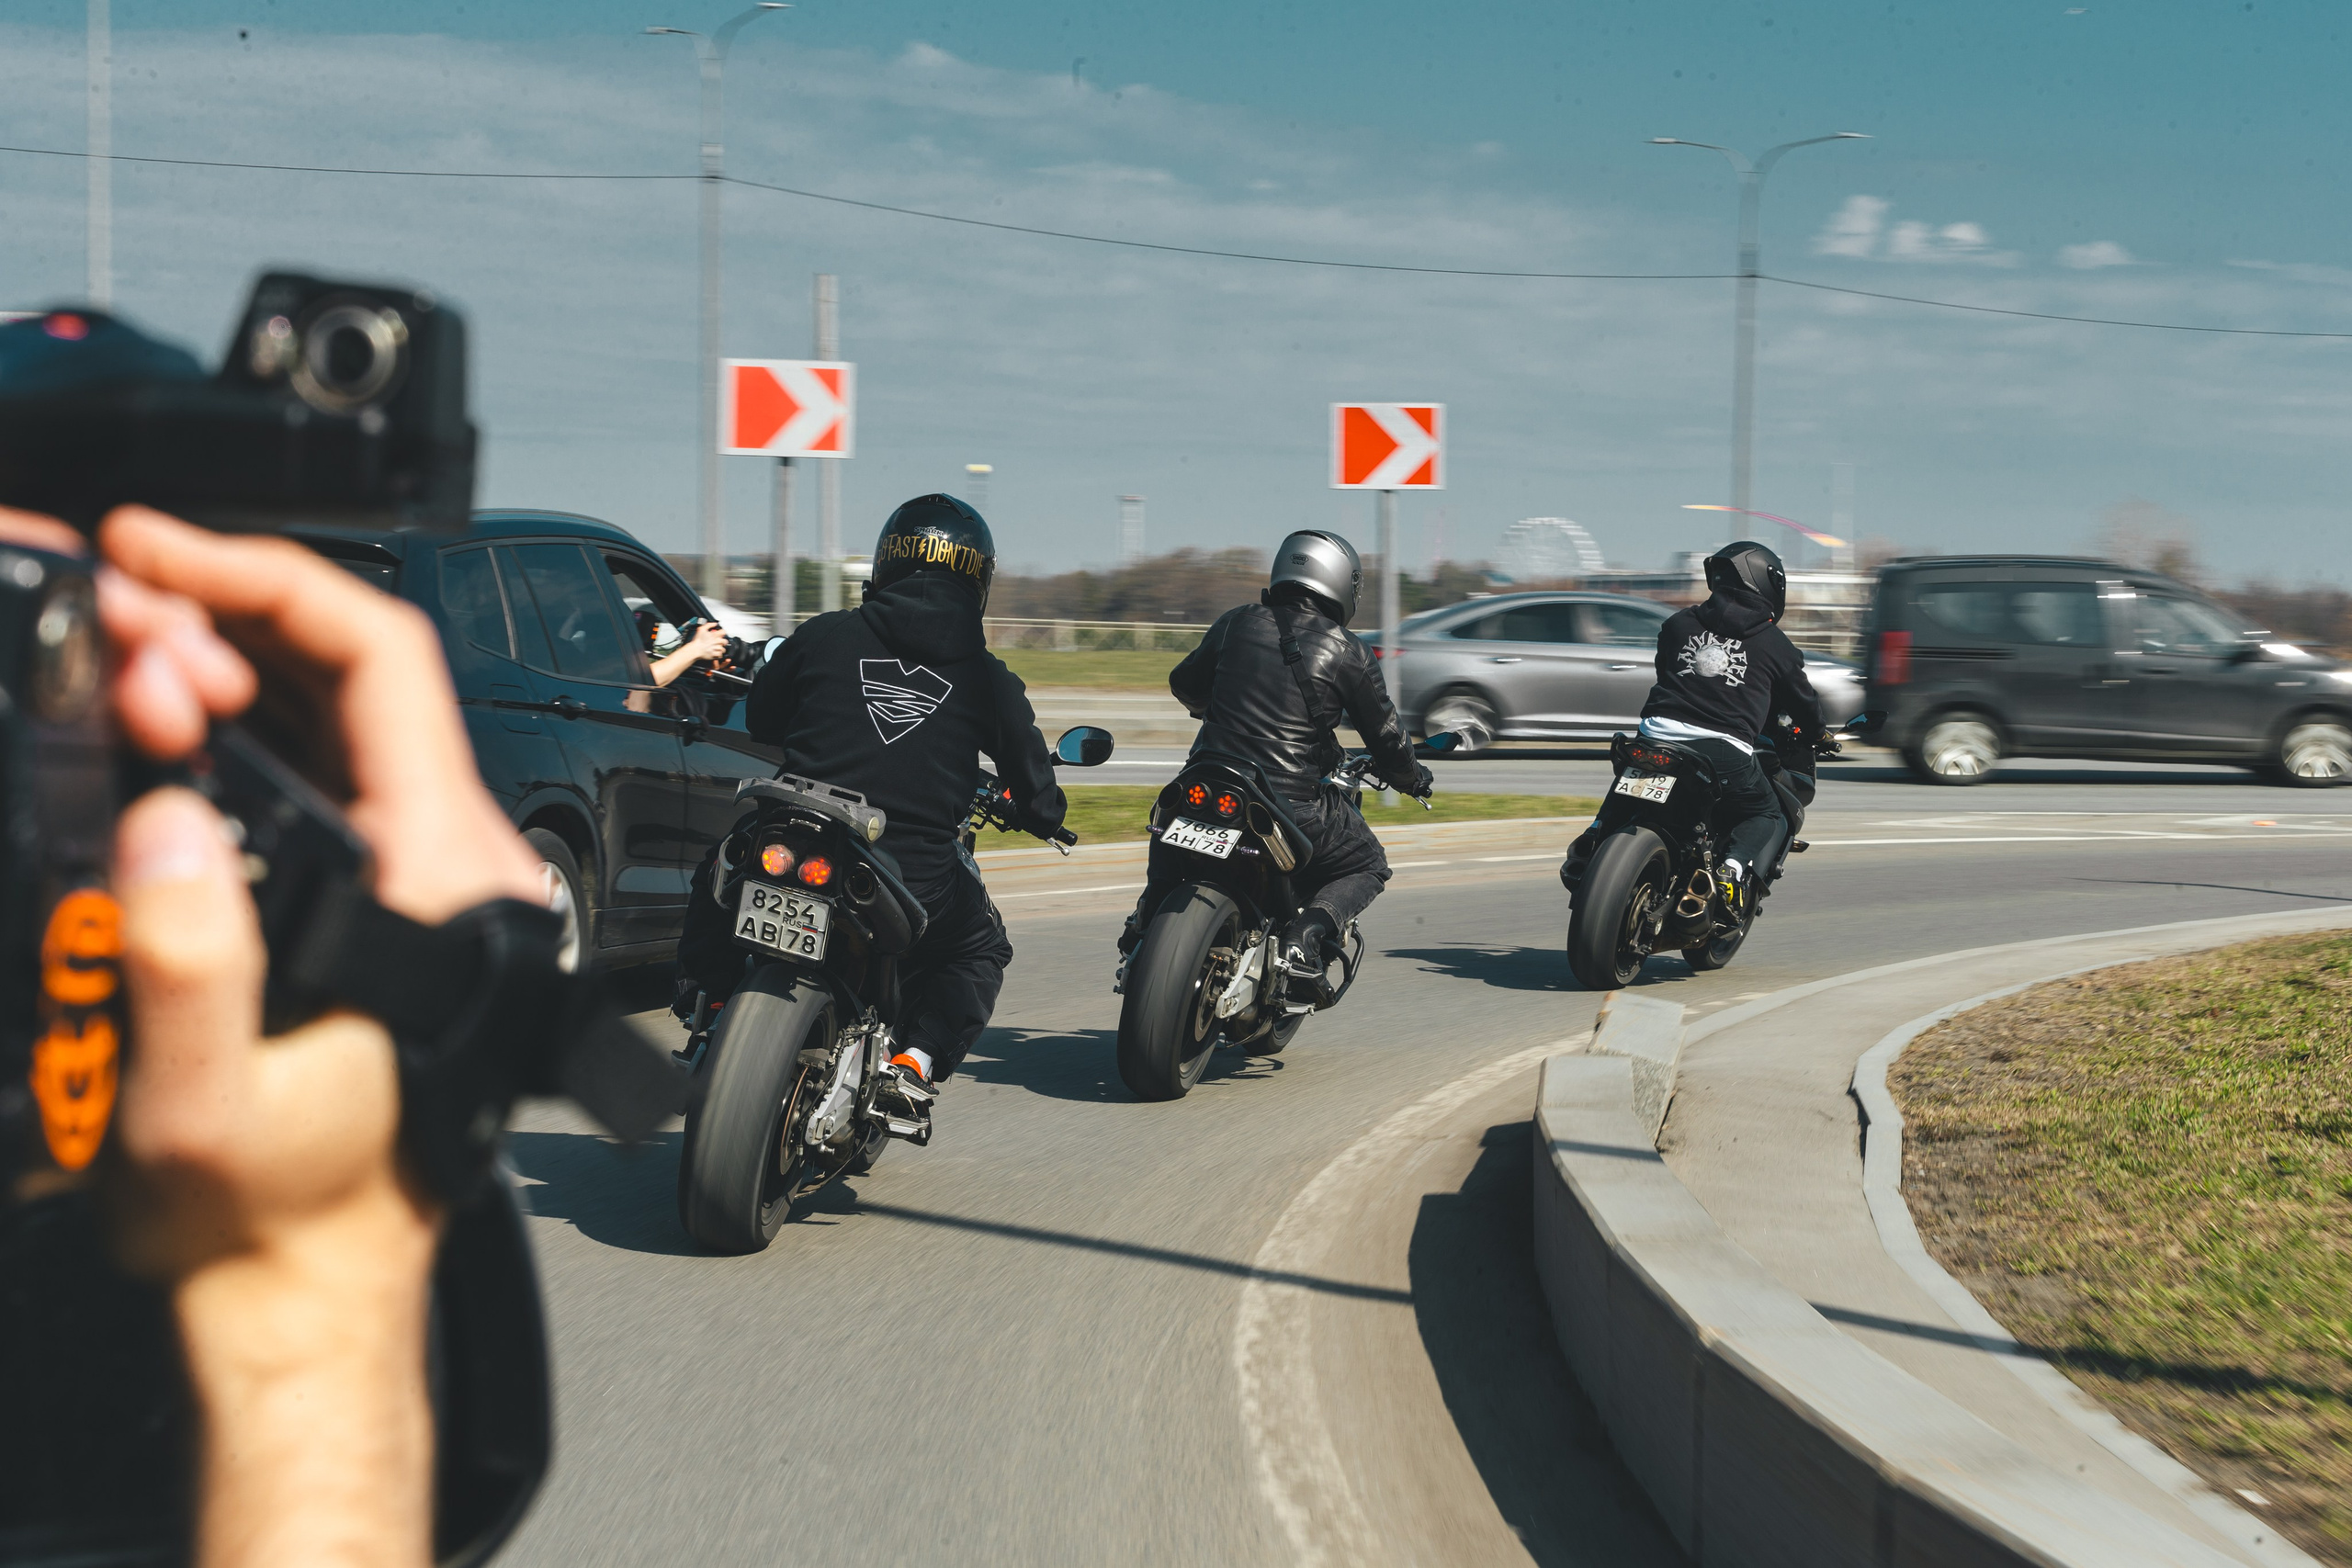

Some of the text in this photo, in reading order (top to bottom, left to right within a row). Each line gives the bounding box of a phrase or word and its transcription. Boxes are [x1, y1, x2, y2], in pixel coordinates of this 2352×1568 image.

[888, 534, 921, 561] FAST
[926, 536, 970, 571] DON'T
[965, 549, 985, 579] DIE
[1645, 788, 1663, 799] 78
[1182, 819, 1228, 839] 7066
[1166, 833, 1226, 854] AH 78
[752, 889, 816, 924] 8254
[782, 917, 802, 929] RUS
[741, 917, 816, 953] AB 78
